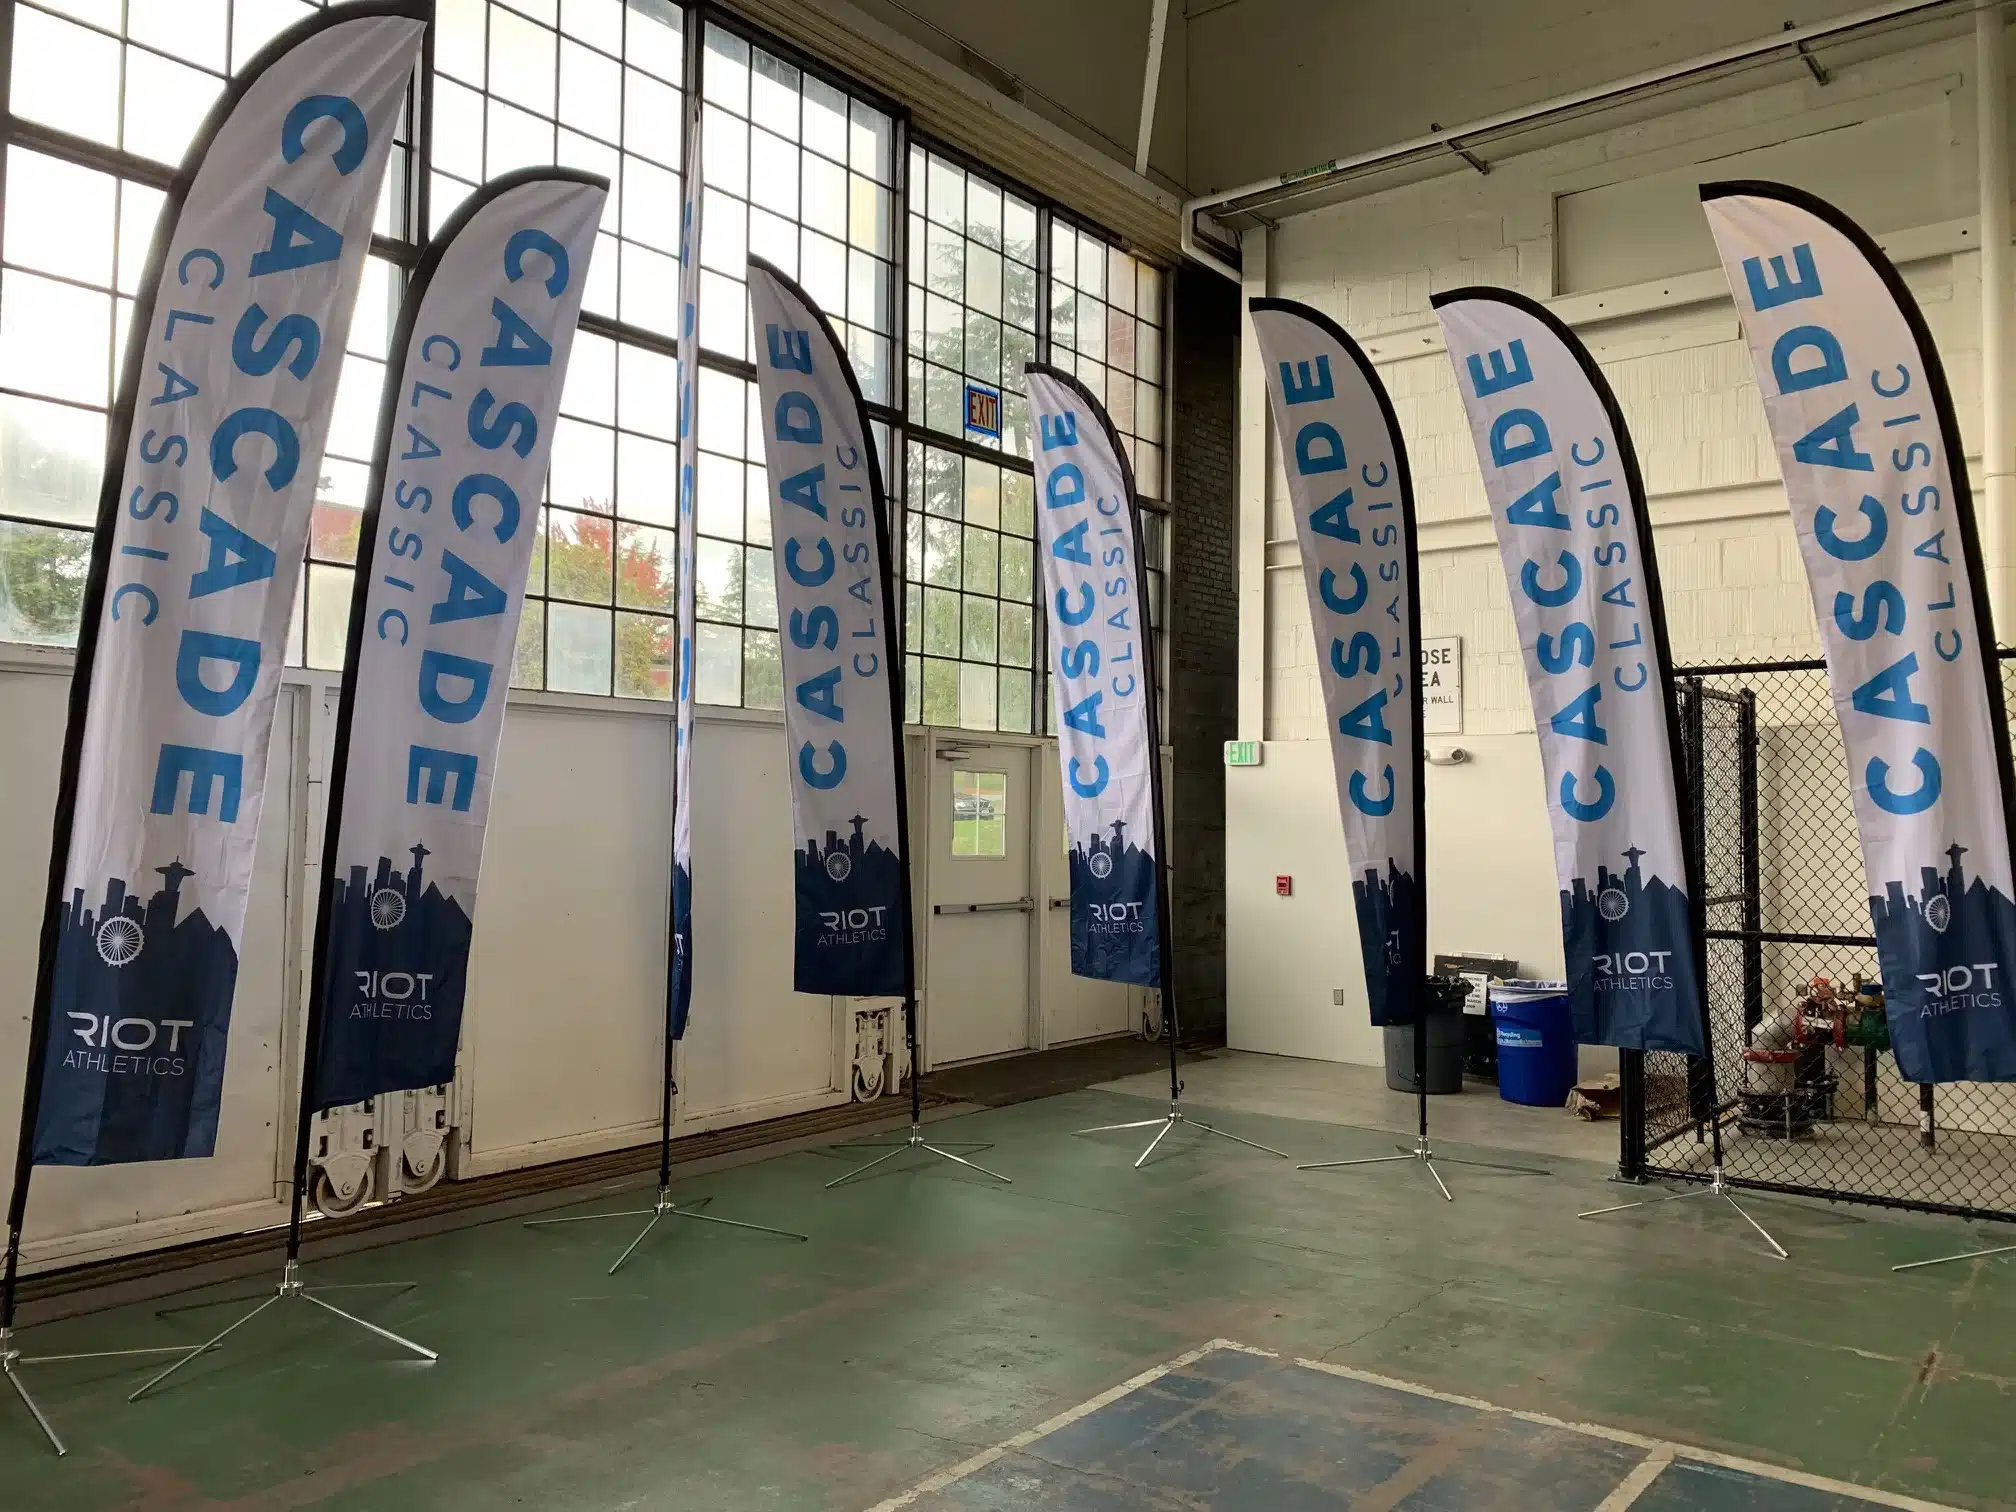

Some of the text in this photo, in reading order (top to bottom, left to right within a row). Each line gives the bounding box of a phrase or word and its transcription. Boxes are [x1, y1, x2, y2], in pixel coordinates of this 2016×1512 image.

[970, 391, 996, 429] EXIT
[111, 247, 225, 627] CLASSIC
[151, 94, 369, 824] CASCADE
[377, 334, 461, 647] CLASSIC
[406, 229, 570, 812] CASCADE
[1742, 243, 1943, 816] CASCADE
[1872, 362, 1962, 663] CLASSIC
[766, 323, 847, 789] CASCADE
[837, 445, 879, 678] CLASSIC
[1571, 436, 1647, 693] CLASSIC
[1097, 494, 1135, 698] CLASSIC
[1279, 354, 1395, 817] CASCADE
[1467, 338, 1616, 822] CASCADE
[1040, 409, 1111, 799] CASCADE
[1431, 695, 1454, 704] WALL
[1229, 741, 1256, 763] EXIT
[819, 906, 886, 931] RIOT
[1088, 922, 1144, 933] ATHLETICS
[1089, 902, 1143, 921] RIOT
[817, 928, 886, 946] ATHLETICS
[1592, 951, 1672, 975] RIOT
[1915, 963, 1998, 997] RIOT
[354, 970, 433, 1000] RIOT
[1593, 976, 1673, 991] ATHLETICS
[349, 1002, 432, 1020] ATHLETICS
[1920, 993, 2002, 1019] ATHLETICS
[66, 1011, 194, 1052] RIOT
[62, 1049, 185, 1076] ATHLETICS
